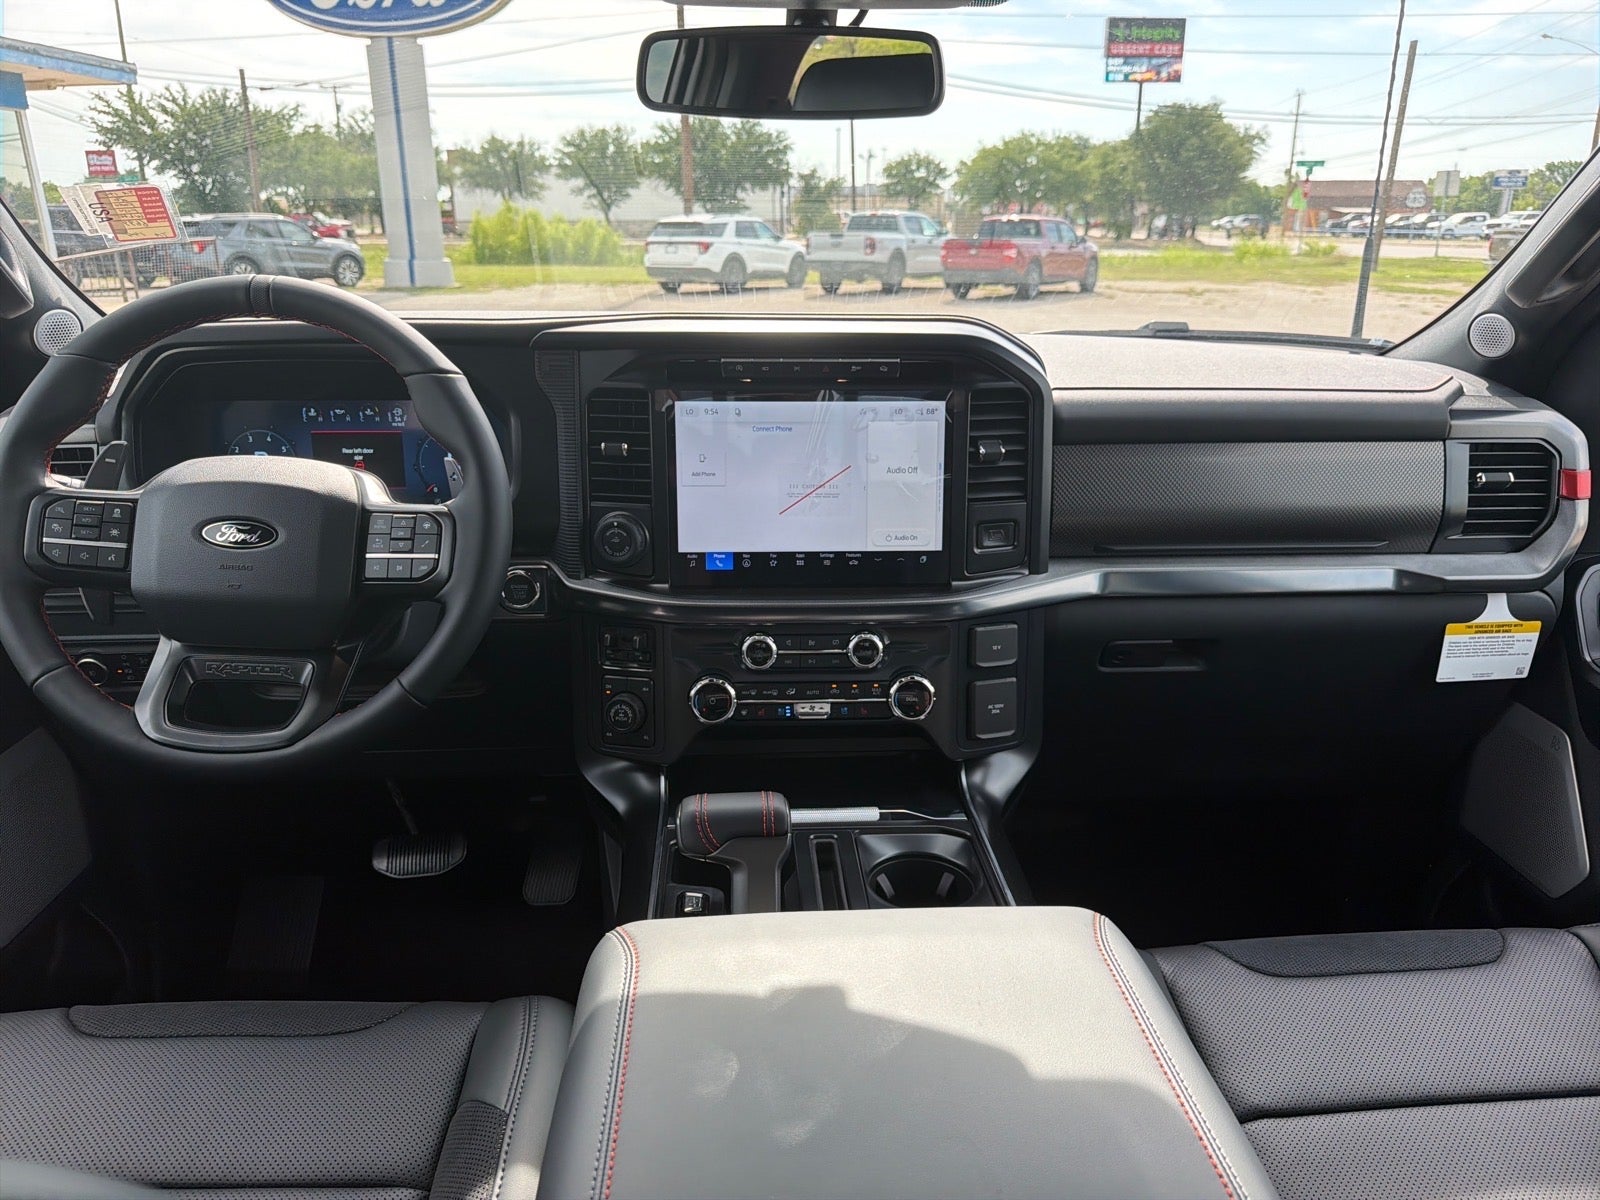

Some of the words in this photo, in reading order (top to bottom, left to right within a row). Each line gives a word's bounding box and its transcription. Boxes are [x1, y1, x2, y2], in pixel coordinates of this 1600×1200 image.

[88, 202, 113, 223] USA
[215, 524, 262, 543] Ford
[206, 661, 294, 679] RAPTOR
